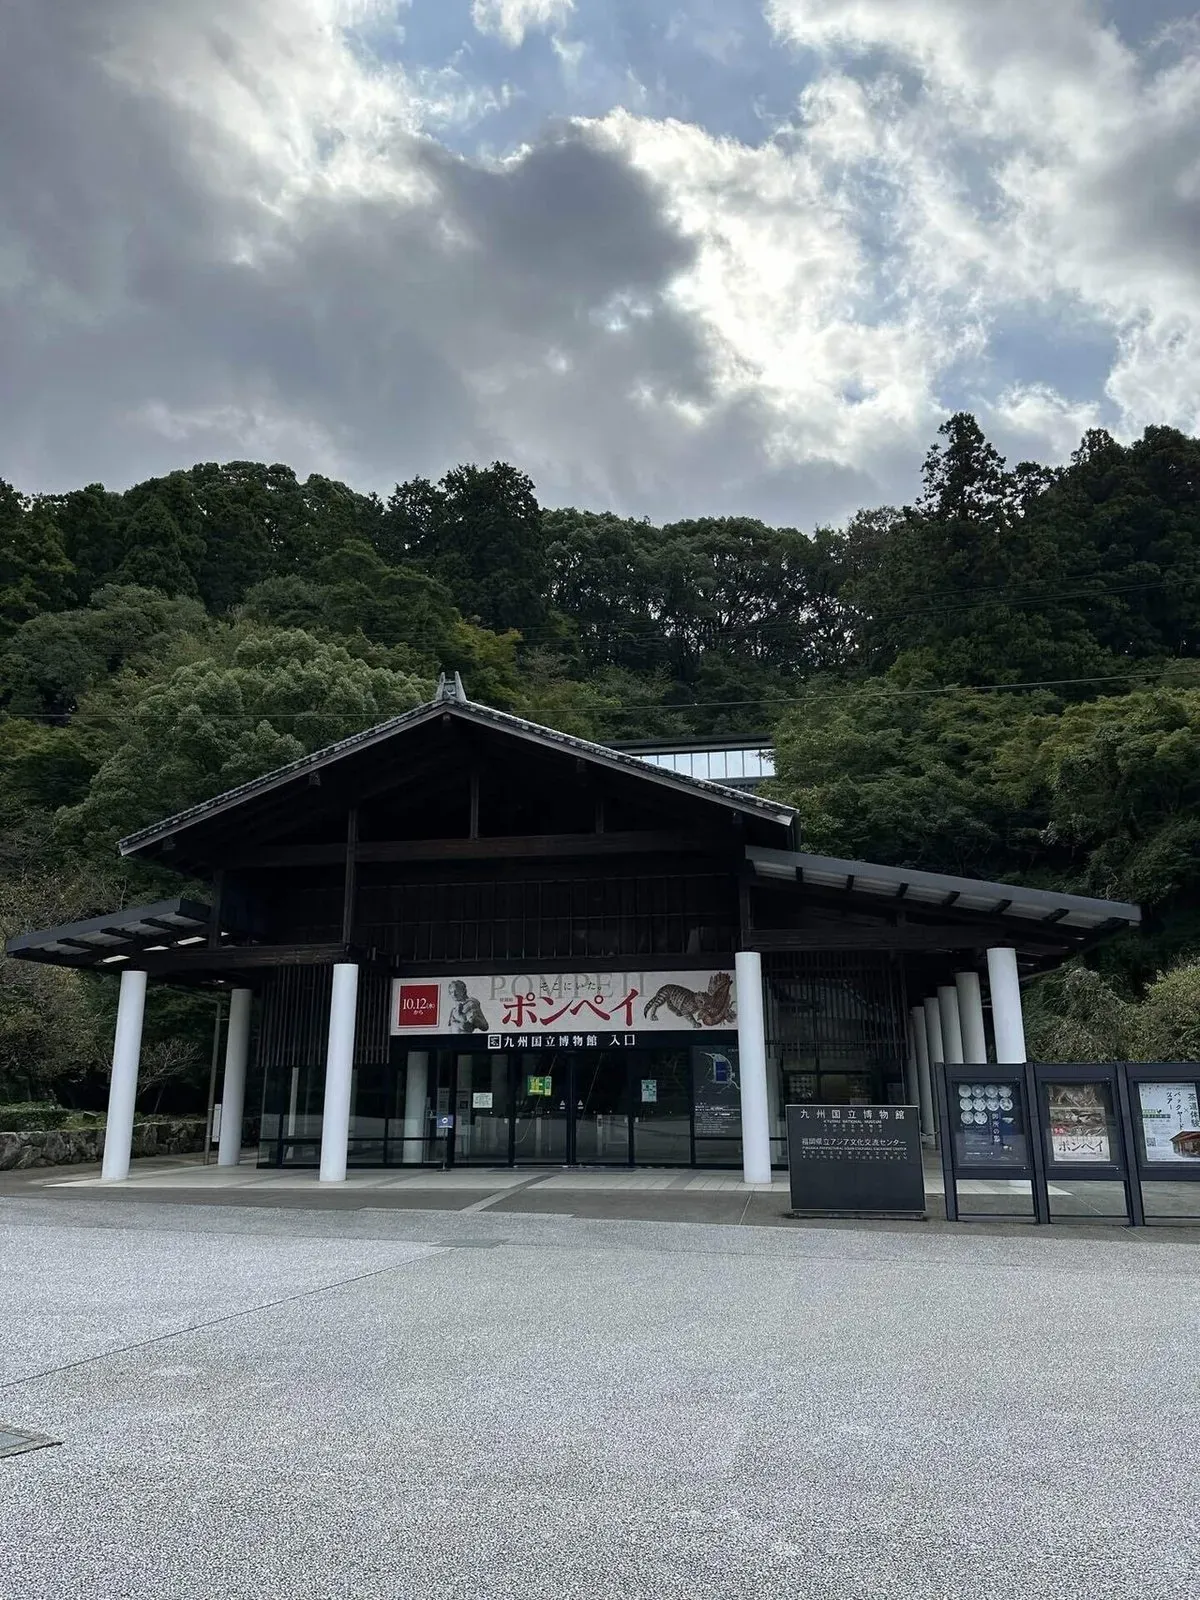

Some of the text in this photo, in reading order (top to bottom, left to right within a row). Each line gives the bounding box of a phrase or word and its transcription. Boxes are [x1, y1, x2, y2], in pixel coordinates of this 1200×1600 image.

[489, 974, 650, 1000] POMPEII
[540, 981, 602, 992] そこにいた。
[502, 988, 639, 1027] ポンペイ
[503, 1034, 636, 1048] 九州国立博物館 入口
[800, 1109, 905, 1120] 九州国立博物館
[802, 1138, 906, 1146] 福岡県立アジア文化交流センター
[1059, 1140, 1102, 1152] ポンペイ
